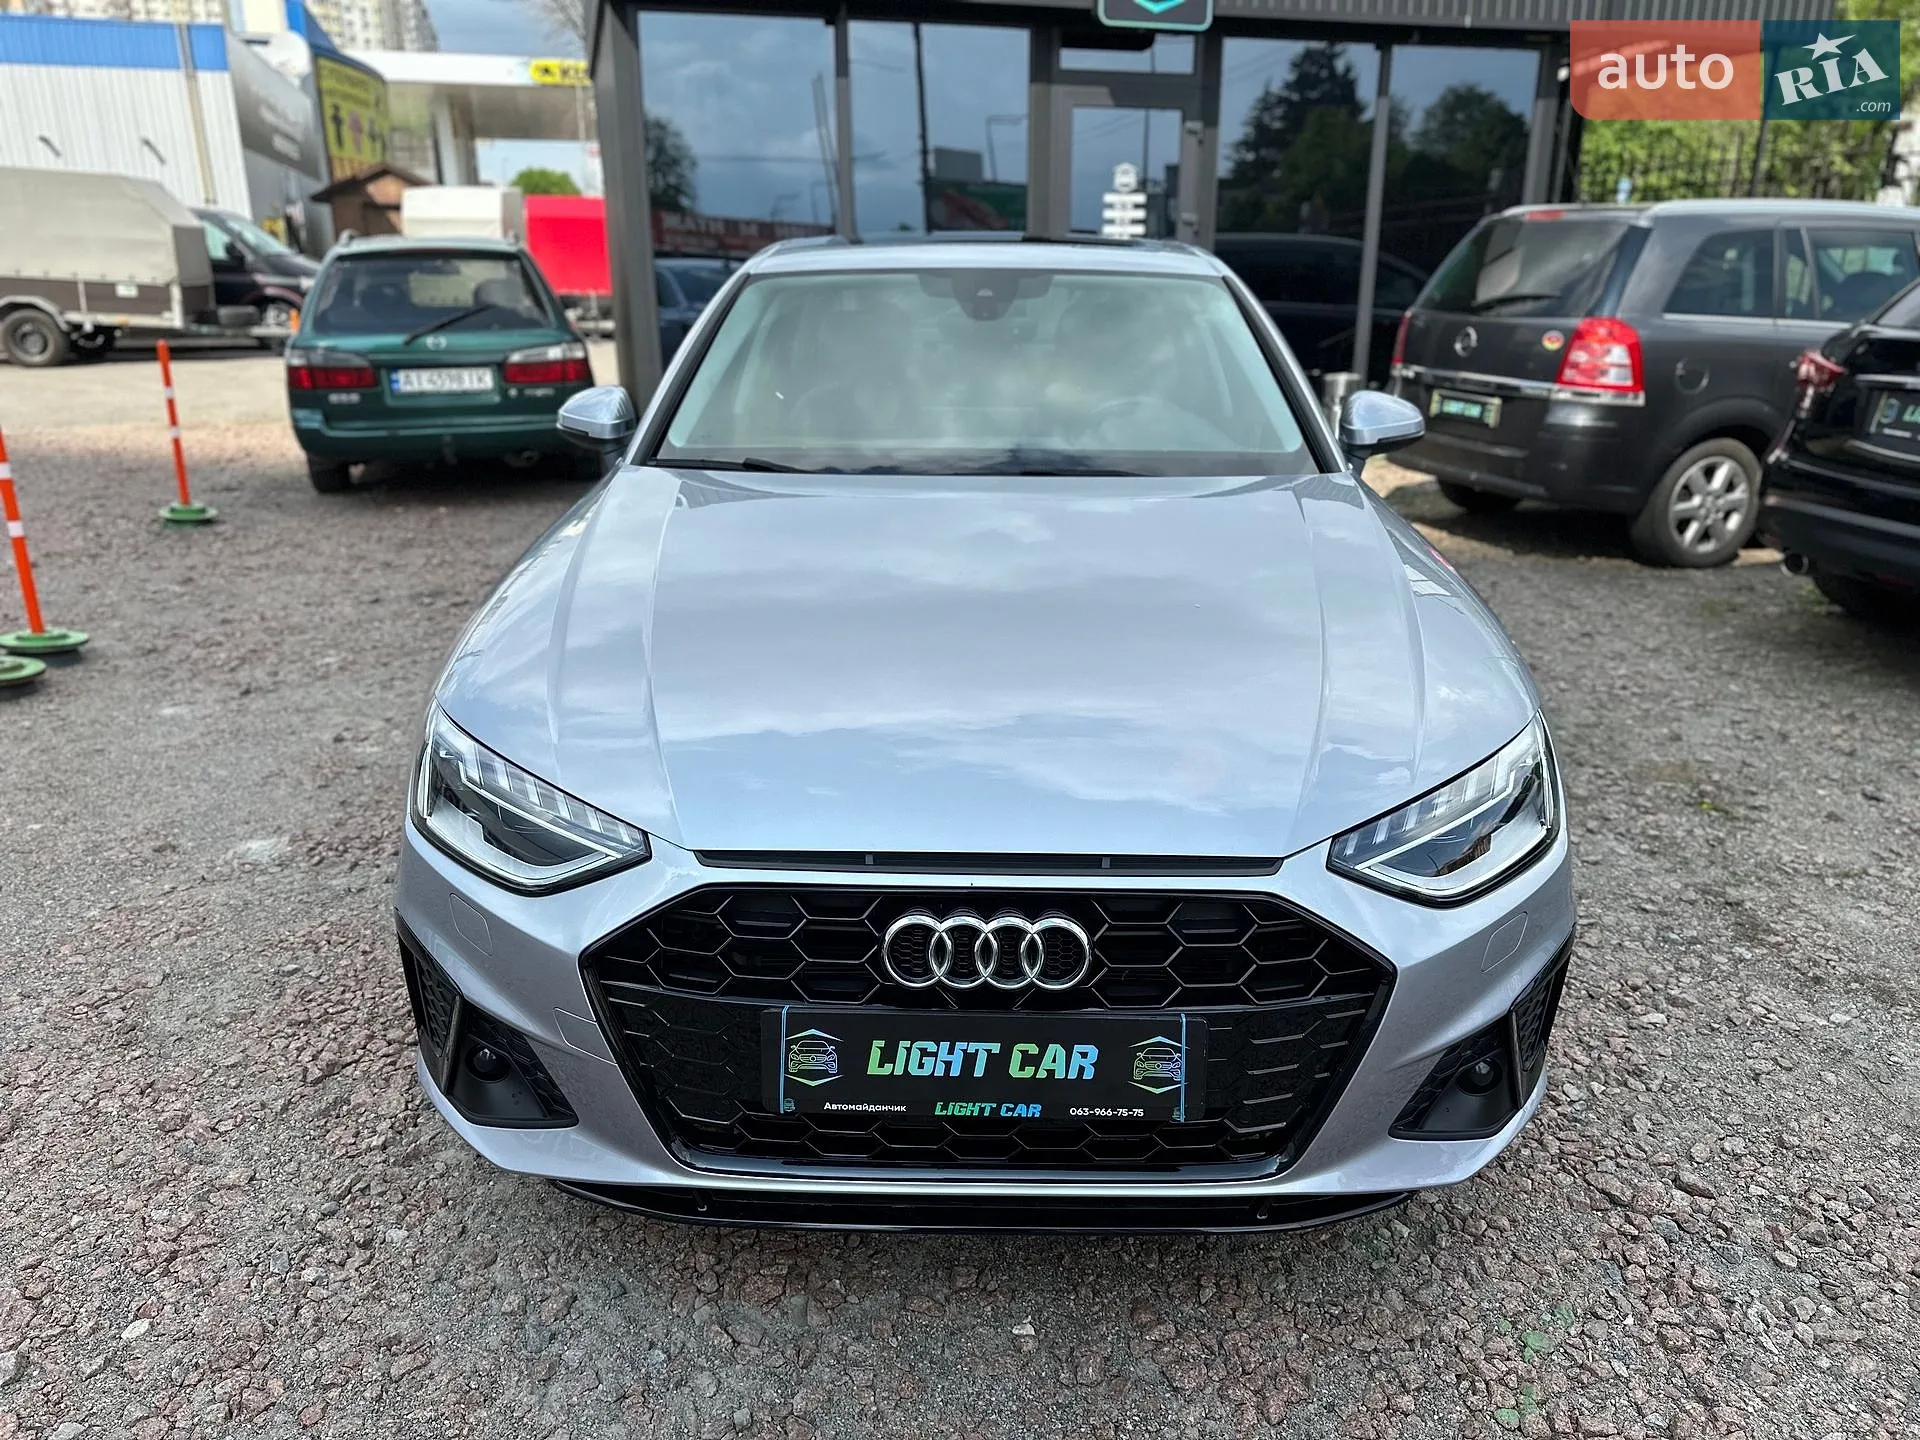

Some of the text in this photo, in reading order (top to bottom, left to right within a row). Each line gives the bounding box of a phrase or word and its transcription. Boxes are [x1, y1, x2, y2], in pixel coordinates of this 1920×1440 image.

[866, 1039, 1099, 1080] LIGHT CAR
[823, 1101, 907, 1113] Автомайданчик
[934, 1101, 1042, 1118] LIGHT CAR
[1069, 1106, 1145, 1118] 063-966-75-75
